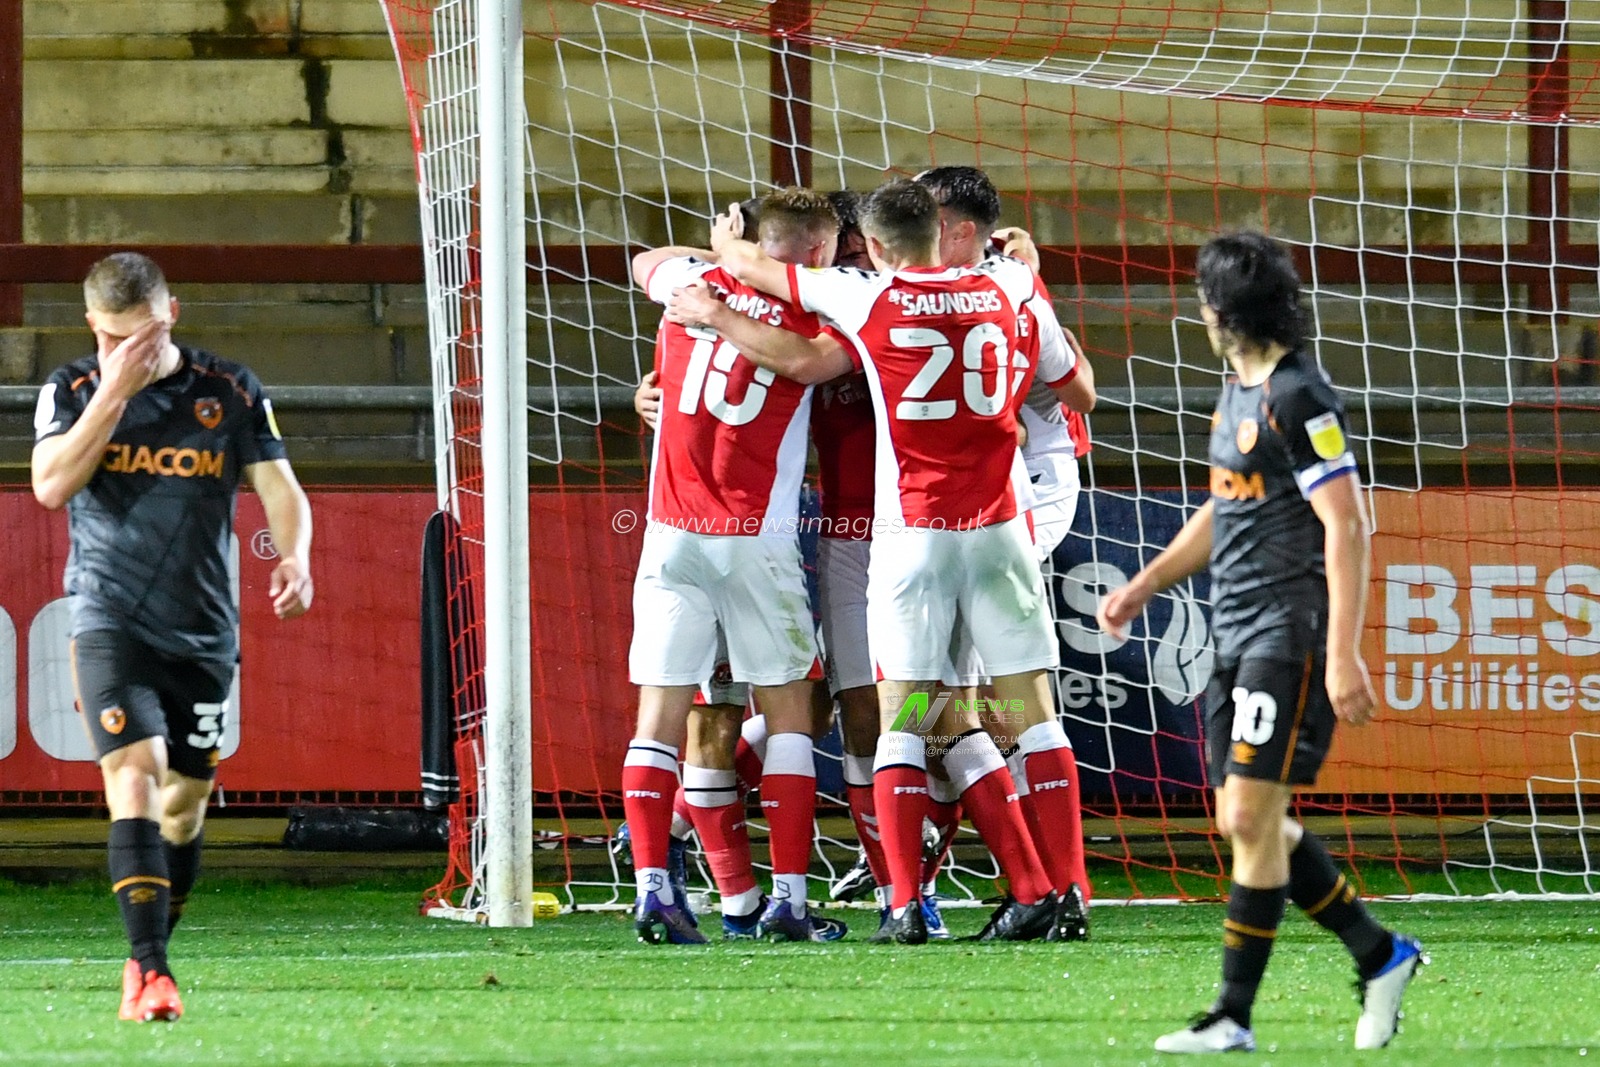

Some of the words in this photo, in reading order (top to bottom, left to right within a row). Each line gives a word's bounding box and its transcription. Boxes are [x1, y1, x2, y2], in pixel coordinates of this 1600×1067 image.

[901, 290, 1002, 316] SAUNDERS
[678, 326, 776, 426] 10
[889, 322, 1008, 420] 20
[103, 442, 226, 479] GIACOM
[1385, 564, 1600, 657] BES
[1385, 661, 1600, 711] Utilities
[1231, 686, 1278, 746] 10
[625, 790, 661, 799] FTFC
[1034, 779, 1069, 792] FTFC
